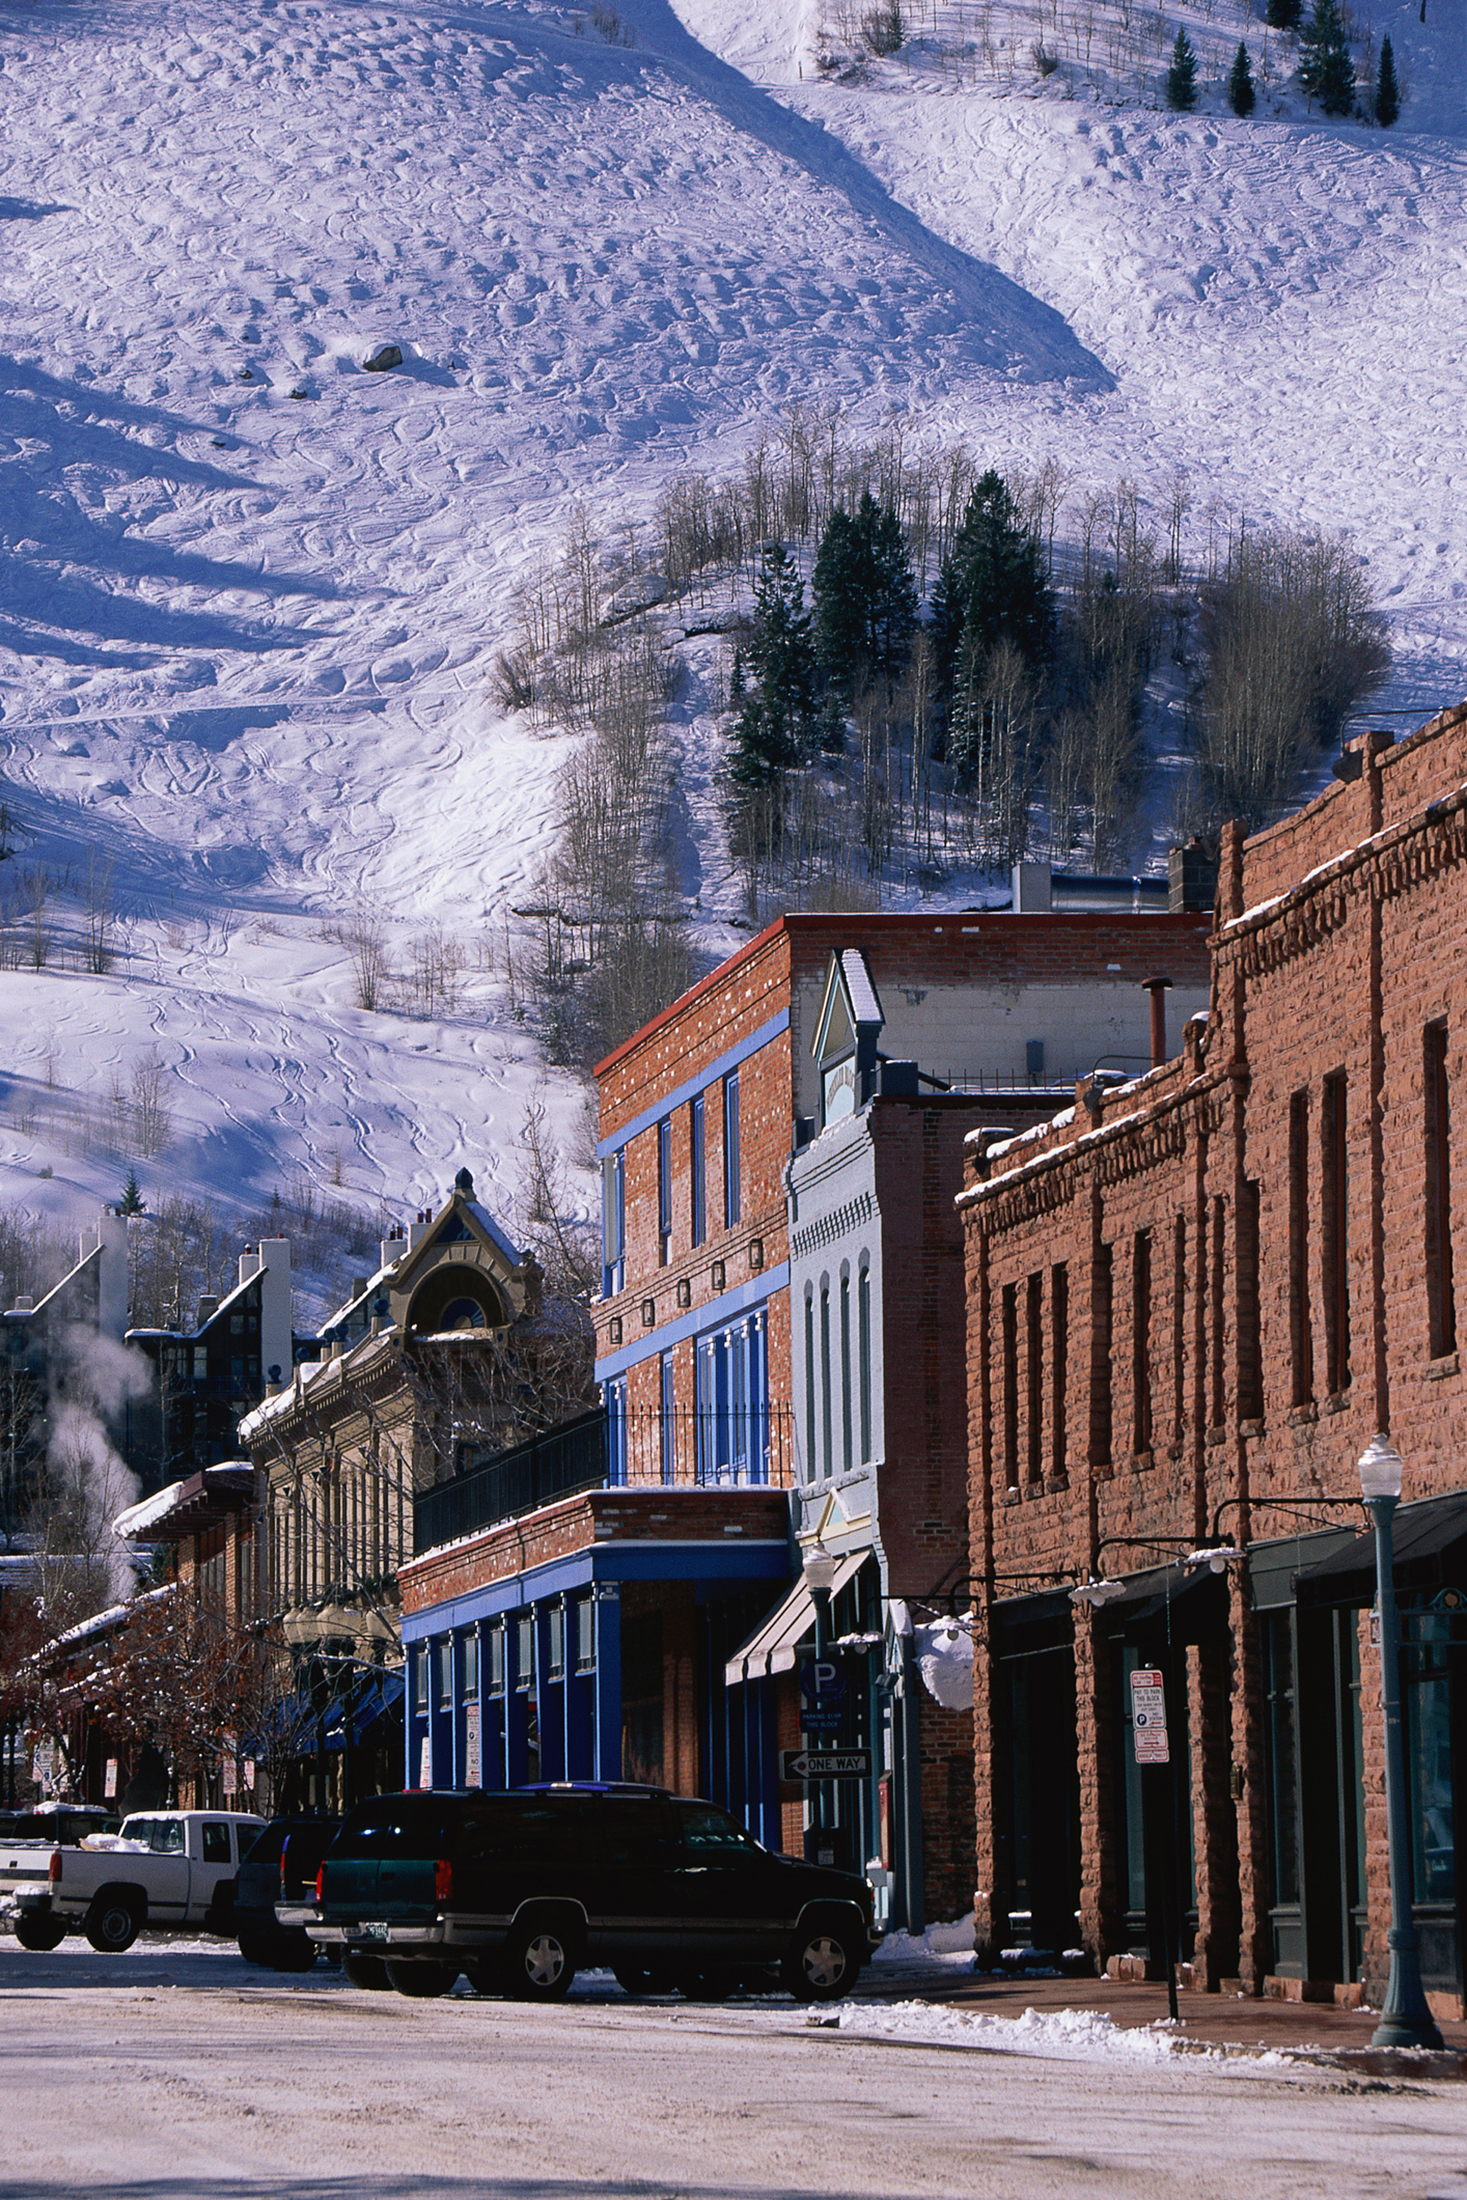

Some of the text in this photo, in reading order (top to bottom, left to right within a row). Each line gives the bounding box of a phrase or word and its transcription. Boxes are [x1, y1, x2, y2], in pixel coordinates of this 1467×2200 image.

[814, 1663, 836, 1693] P
[808, 1757, 861, 1770] ONE WAY
